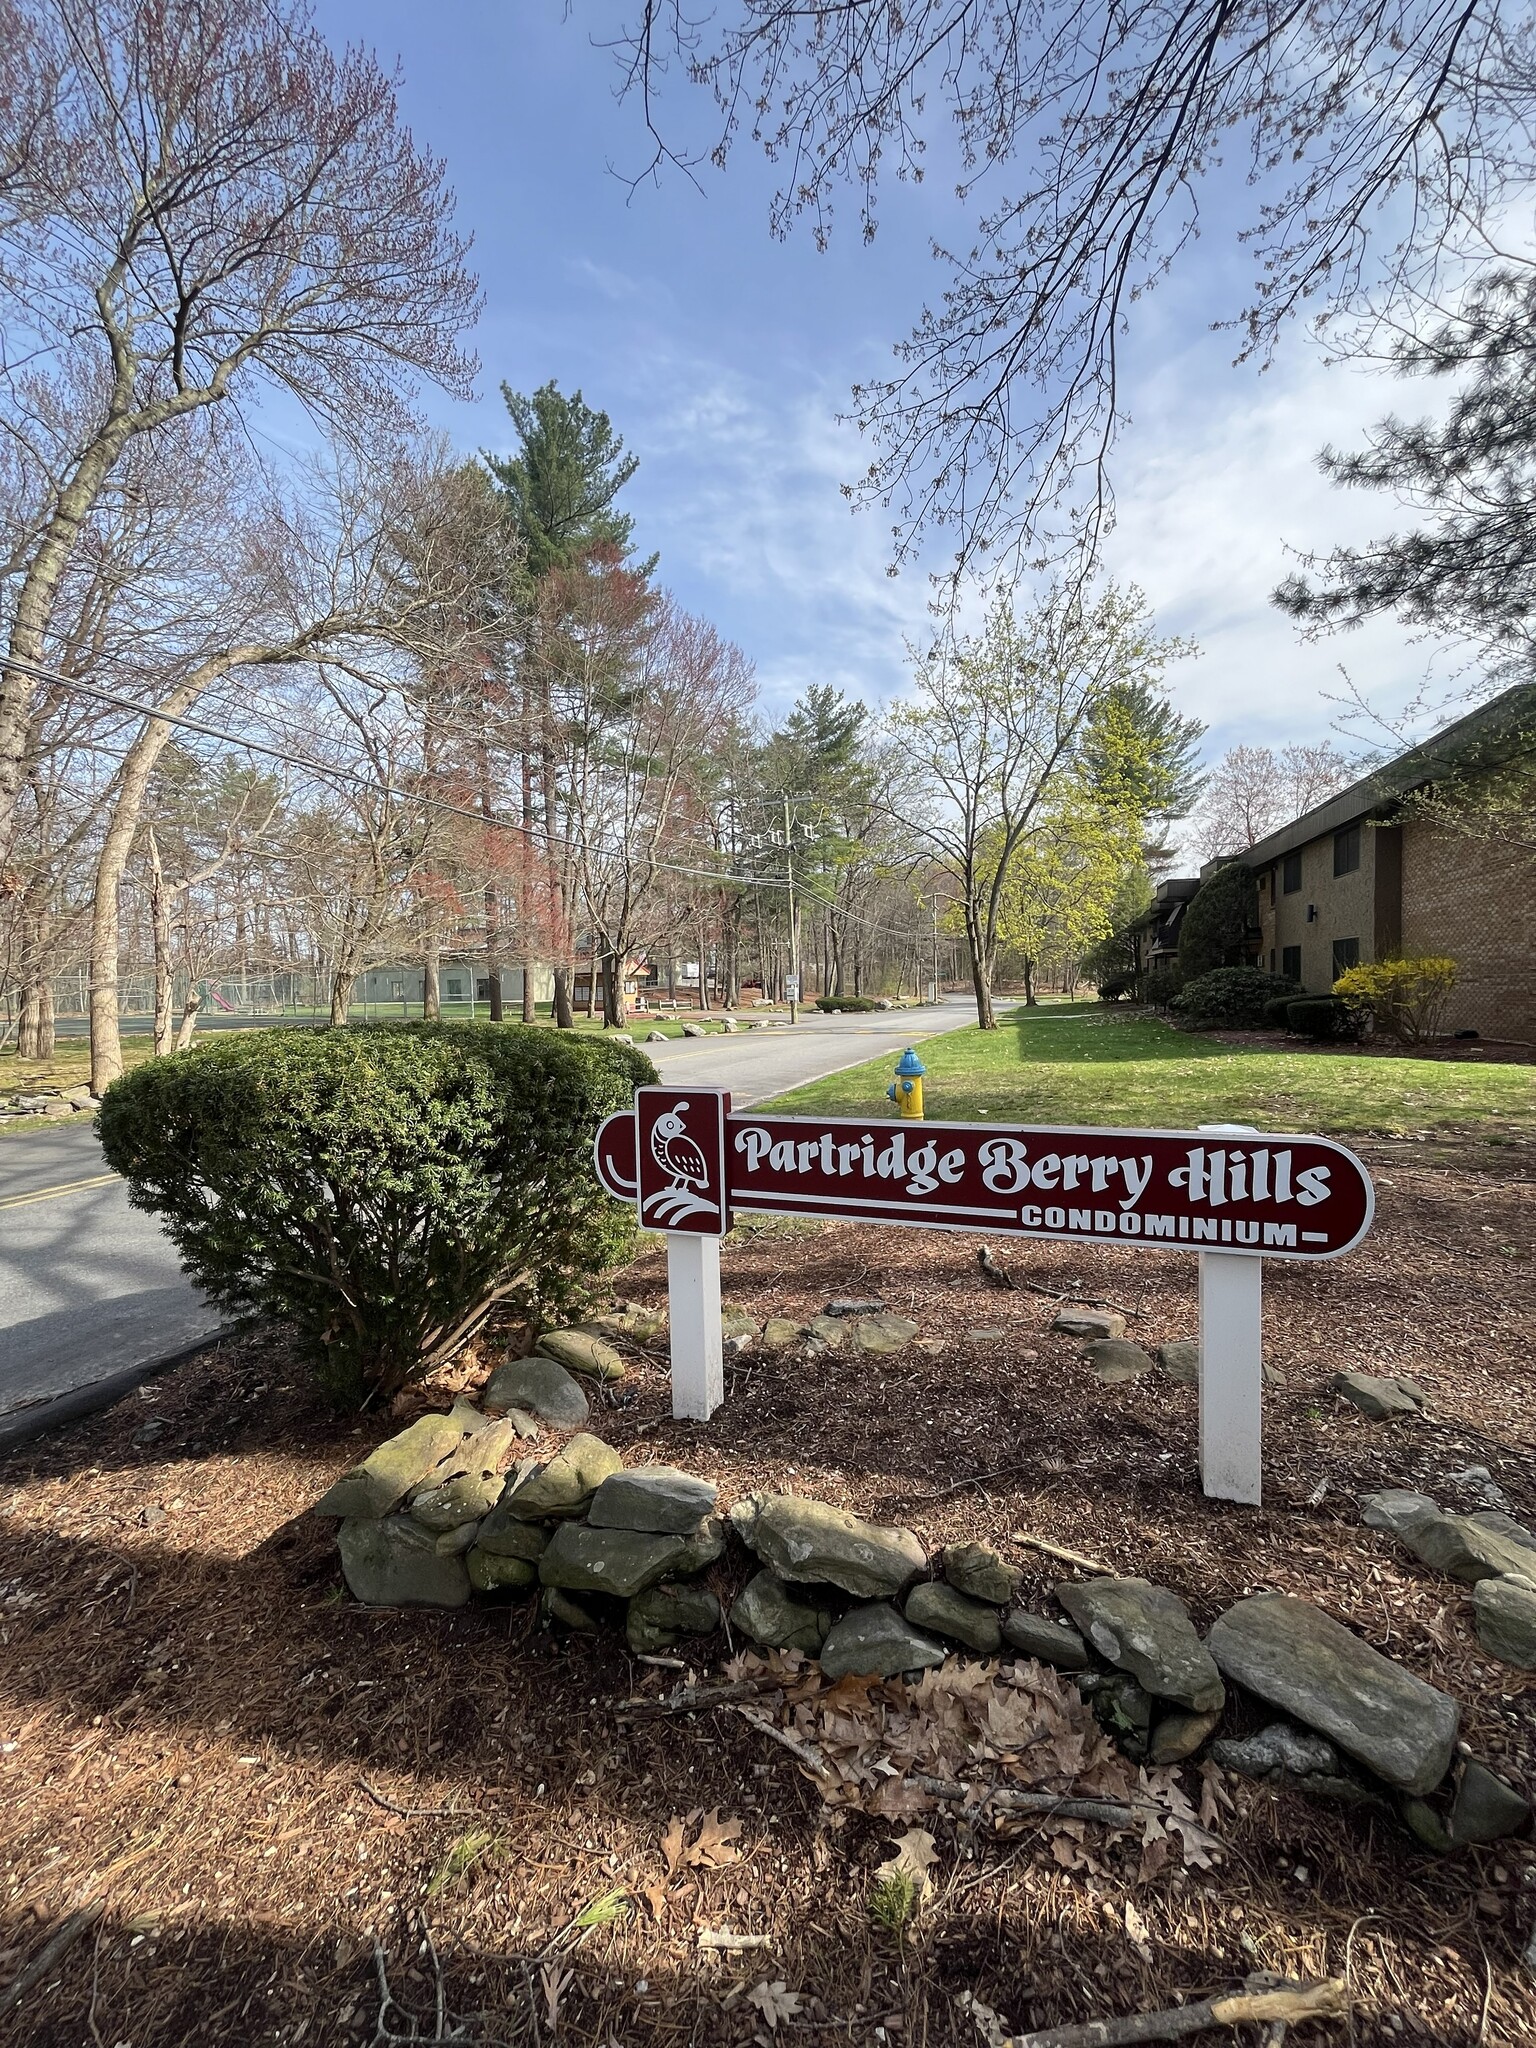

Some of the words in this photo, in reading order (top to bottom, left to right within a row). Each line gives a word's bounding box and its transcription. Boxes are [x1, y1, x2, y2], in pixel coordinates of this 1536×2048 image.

[734, 1127, 965, 1195] Partridge
[977, 1137, 1153, 1211] Berry
[1167, 1146, 1331, 1206] Hills
[1021, 1204, 1297, 1247] CONDOMINIUM
